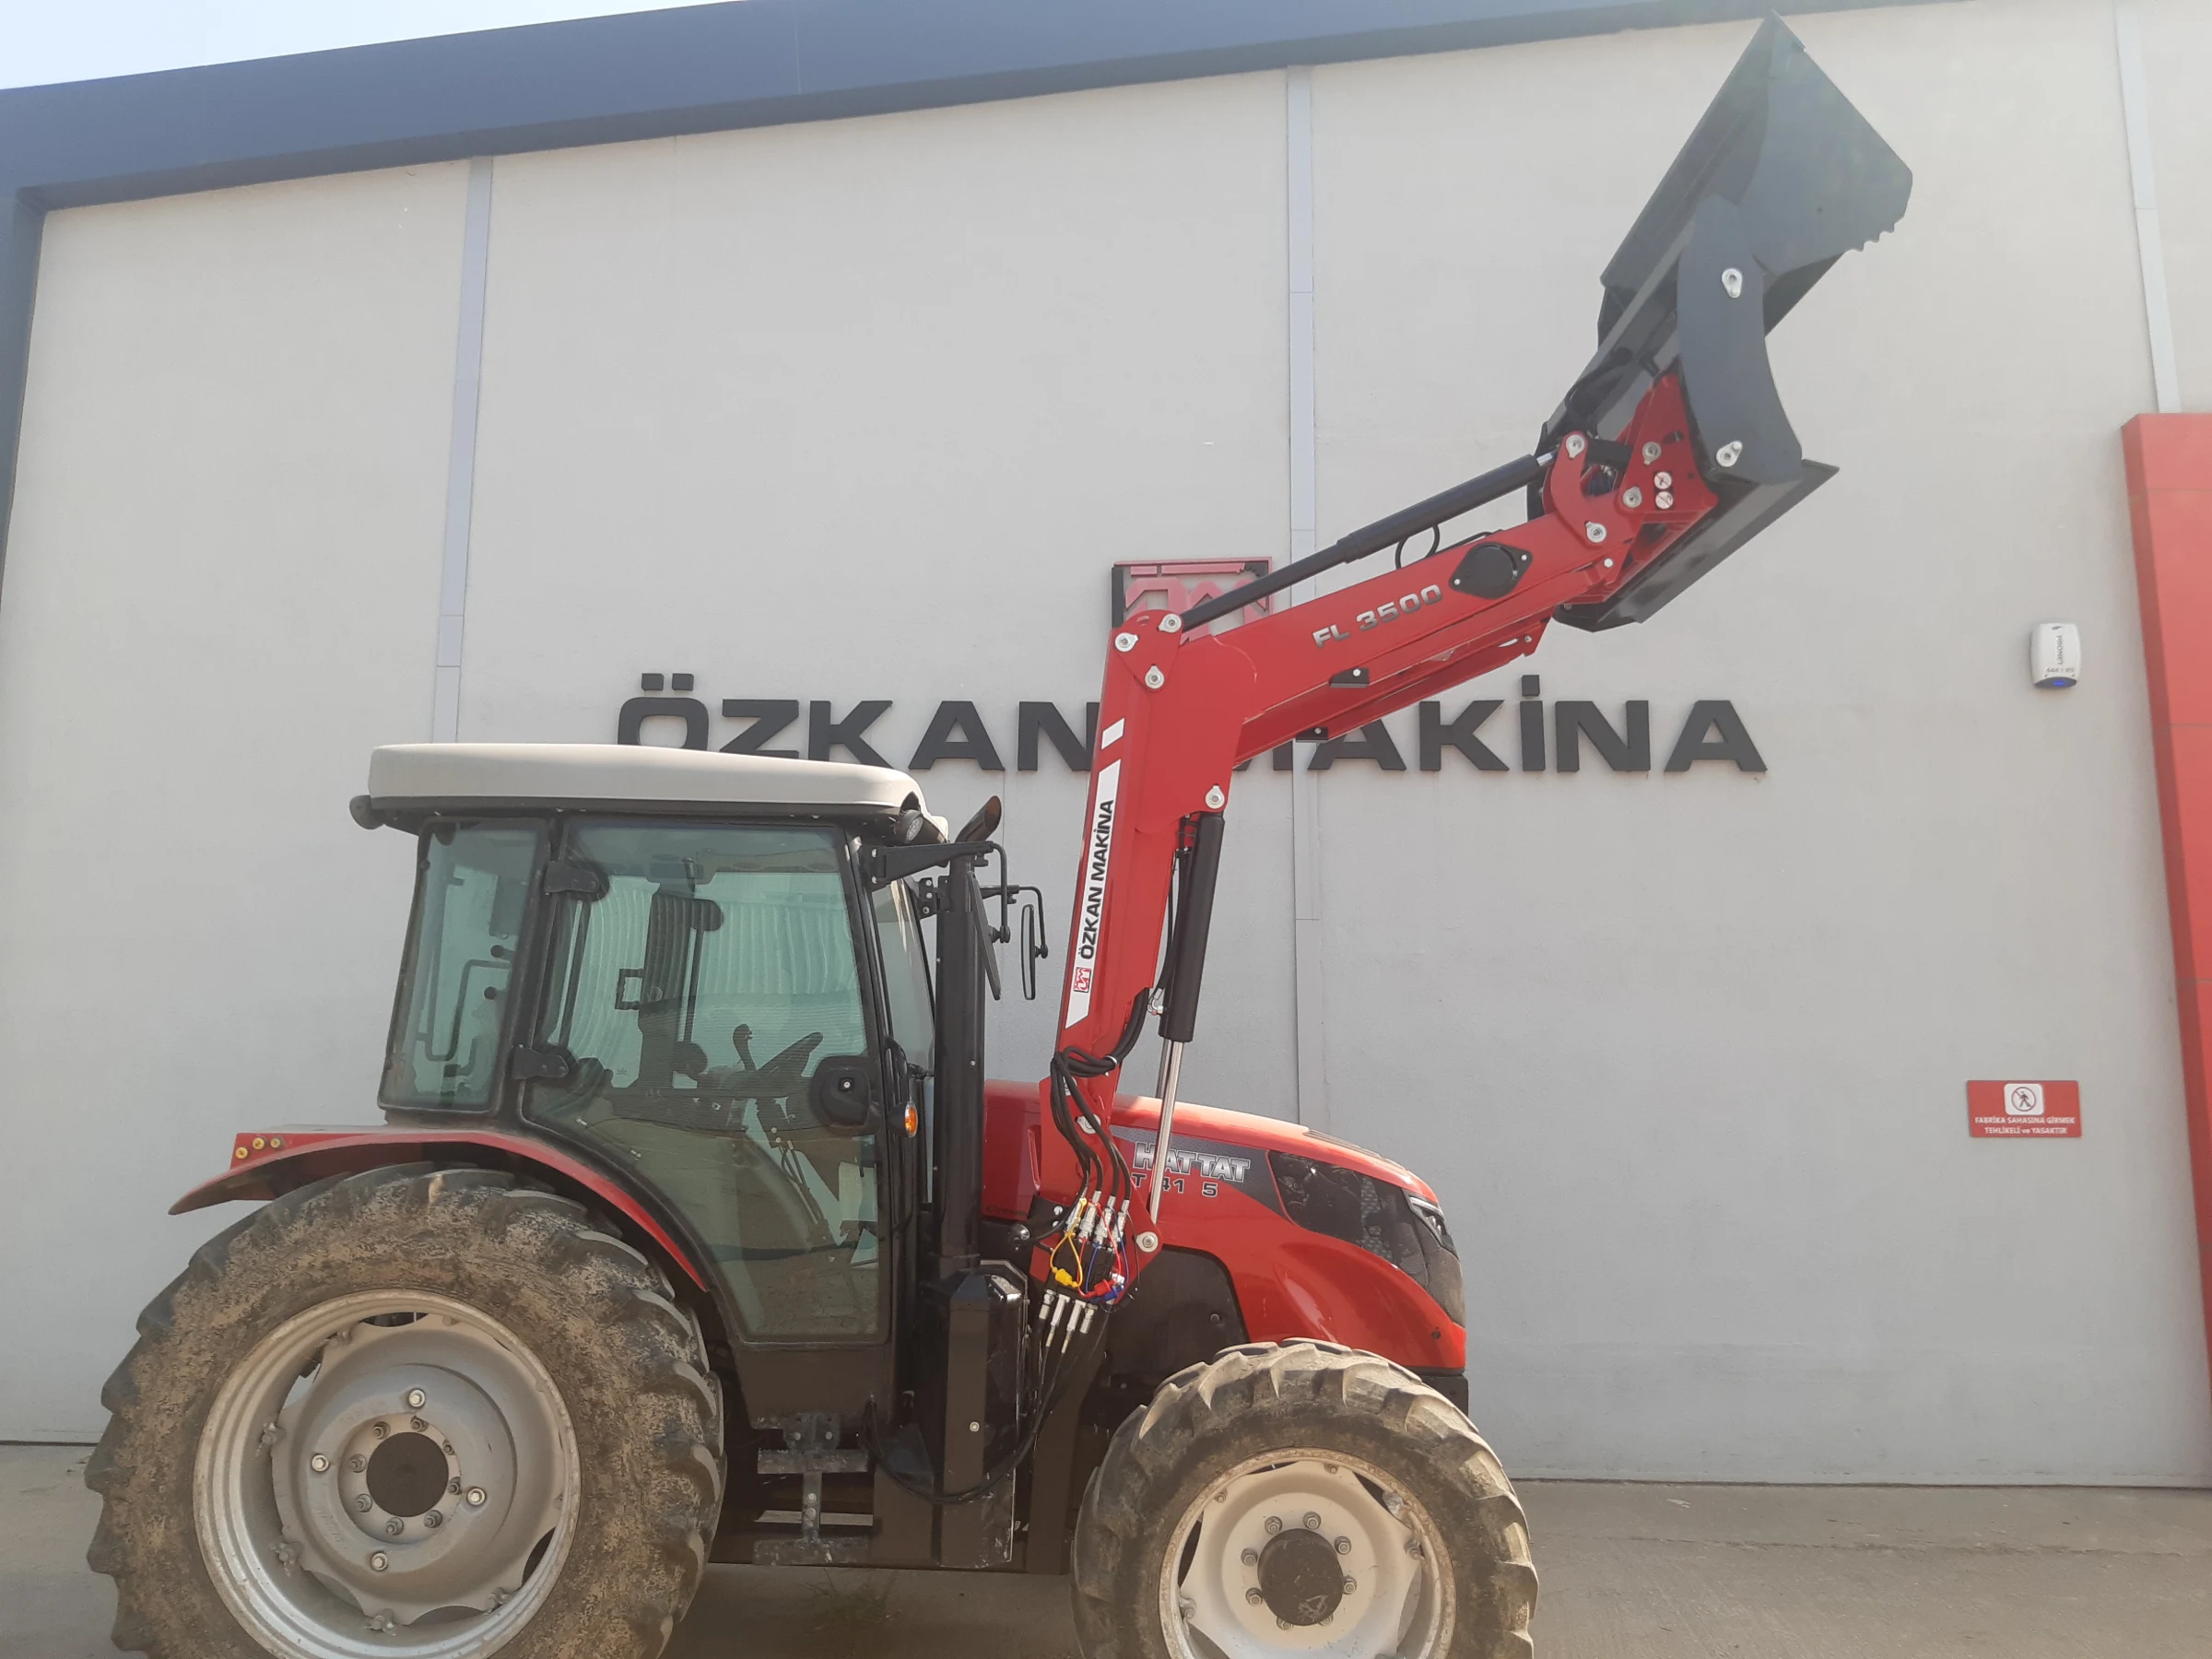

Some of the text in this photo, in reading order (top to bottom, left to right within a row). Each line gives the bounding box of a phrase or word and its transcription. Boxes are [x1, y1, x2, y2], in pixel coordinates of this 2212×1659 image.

[1312, 584, 1442, 650] FL 3500
[617, 672, 1768, 773] ÖZKAN AKİNA
[1090, 800, 1114, 882] MAKİNA
[1078, 887, 1103, 959] ÖZKAN
[1974, 1116, 2075, 1124] FABRİKA SAHASINA GİRMEK
[1984, 1125, 2020, 1135] TEHLİKELİ
[1133, 1141, 1251, 1182] HATTAT
